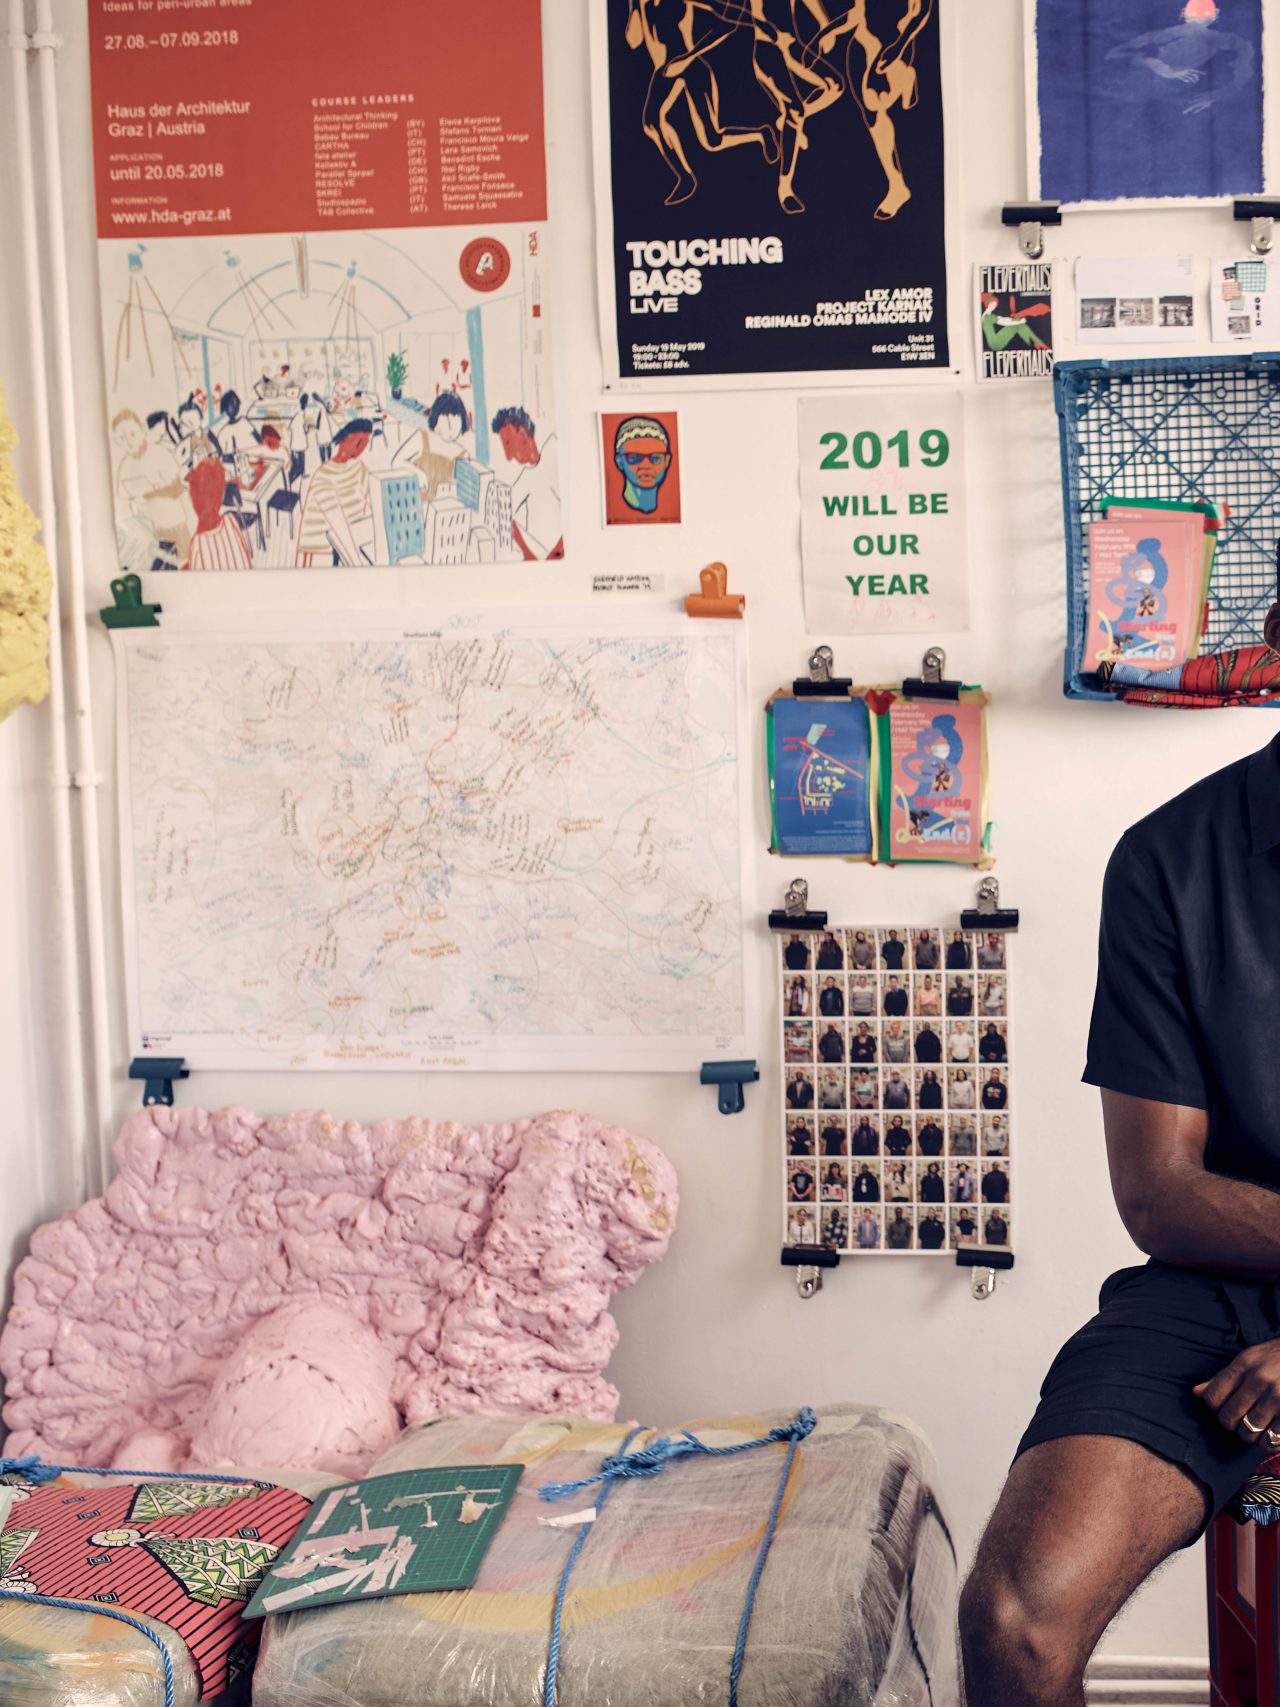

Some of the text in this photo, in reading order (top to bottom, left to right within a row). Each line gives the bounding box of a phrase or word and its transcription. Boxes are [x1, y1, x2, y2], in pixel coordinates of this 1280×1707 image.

[107, 100, 252, 119] Haus der Architektur
[312, 94, 415, 107] COURSE LEADERS
[108, 121, 206, 137] Graz Austria
[110, 163, 224, 180] until 20.05.2018
[112, 207, 231, 225] www.hda-graz.at
[529, 231, 538, 256] HDA
[626, 236, 784, 269] TOUCHING
[628, 268, 703, 297] BASS
[980, 264, 1052, 294] FLEDERMAUS
[865, 287, 933, 302] LEX AMOR
[630, 296, 679, 315] LIVE
[816, 299, 933, 316] PROJECT KARNAK
[745, 311, 934, 329] REGINALD OMAS MAMODE IV
[631, 343, 660, 354] Sunday
[669, 342, 688, 353] May
[687, 341, 706, 351] 2019
[887, 343, 935, 353] Cable Street
[907, 334, 925, 344] Unit
[982, 349, 1055, 378] FLEDERMAUS
[819, 429, 950, 470] 2019
[822, 493, 949, 516] WILL BE
[852, 534, 920, 556] OUR
[845, 574, 930, 596] YEAR
